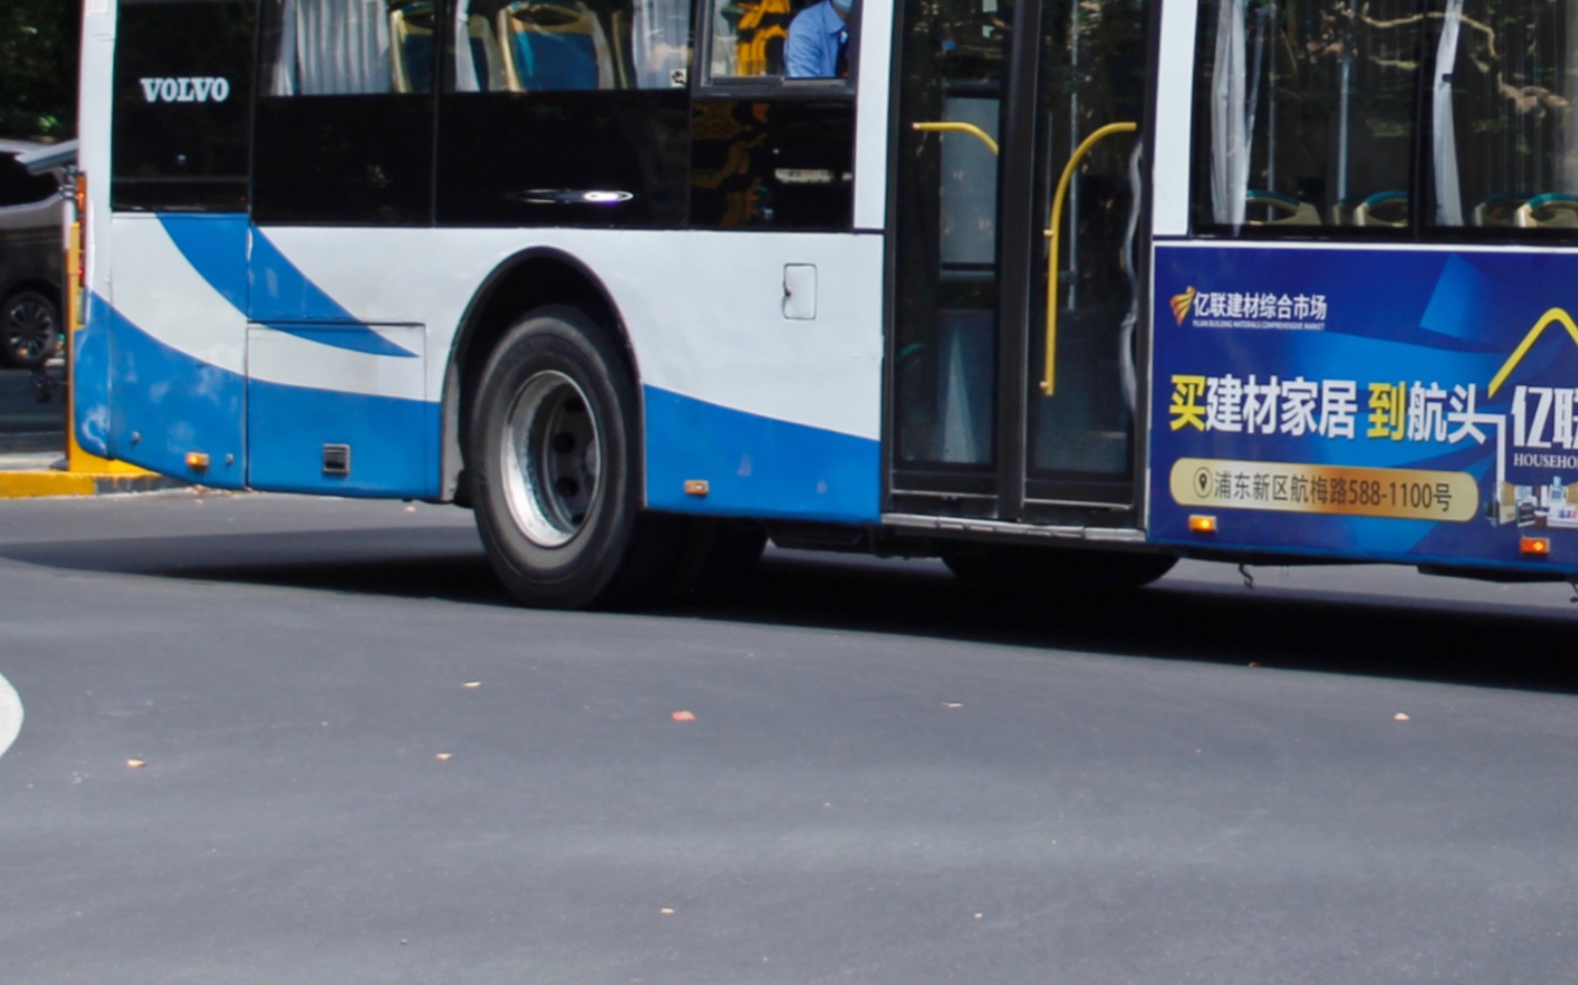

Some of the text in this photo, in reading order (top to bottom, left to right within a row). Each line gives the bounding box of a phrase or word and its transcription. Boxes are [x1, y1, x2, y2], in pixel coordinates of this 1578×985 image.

[139, 76, 230, 103] VOLVO
[1194, 291, 1328, 321] 亿联建材综合市场
[1169, 373, 1487, 444] 买建材家居 到航头
[1214, 470, 1453, 513] 浦东新区航梅路588-1100号
